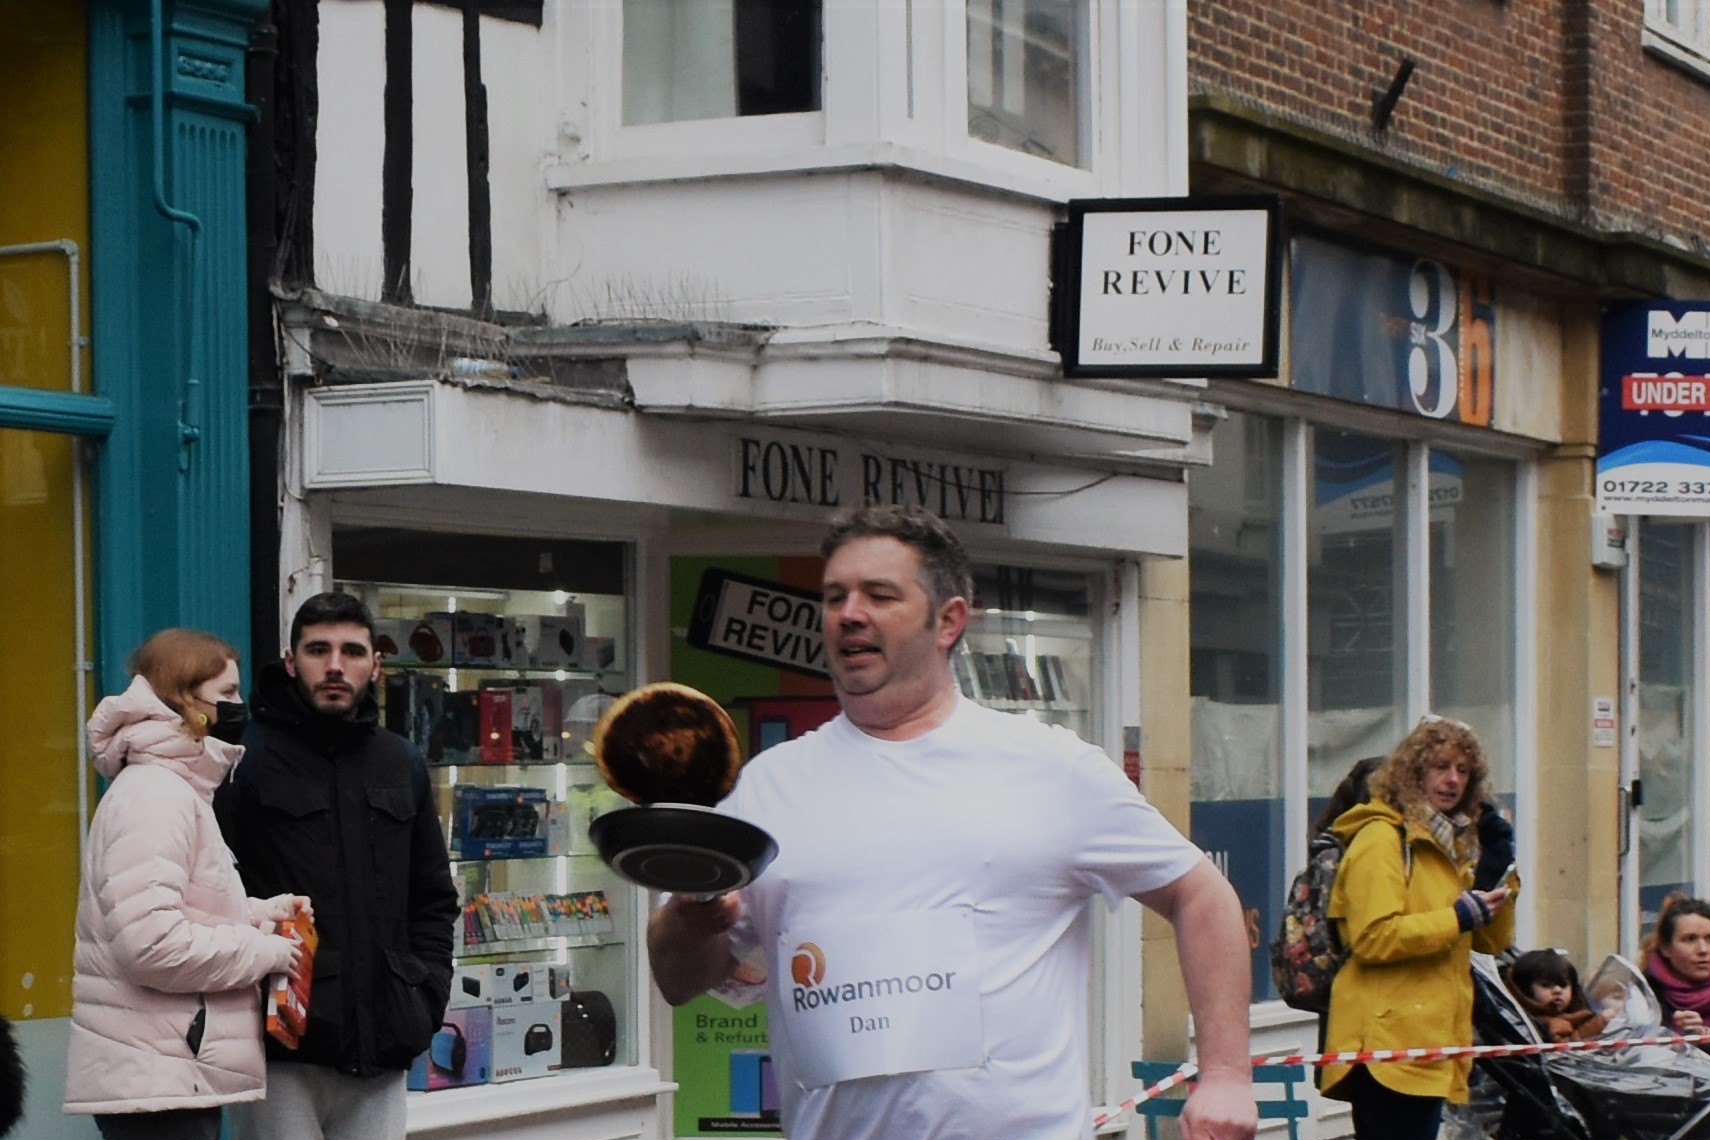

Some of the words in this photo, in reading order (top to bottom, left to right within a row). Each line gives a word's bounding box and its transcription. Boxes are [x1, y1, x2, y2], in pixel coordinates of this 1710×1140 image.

[1128, 230, 1222, 256] FONE
[1102, 269, 1247, 295] REVIVE
[1092, 337, 1161, 356] Buy,Sell
[1168, 340, 1183, 351] &
[1192, 337, 1250, 356] Repair
[1631, 381, 1706, 405] UNDER
[740, 438, 839, 506] FONE
[861, 453, 1004, 524] REVIVE
[1603, 480, 1668, 493] 01722
[723, 616, 827, 668] REVIV
[792, 971, 957, 1013] Rowanmoor
[696, 1013, 758, 1029] Brand
[849, 1015, 891, 1034] Dan
[696, 1031, 707, 1043] &
